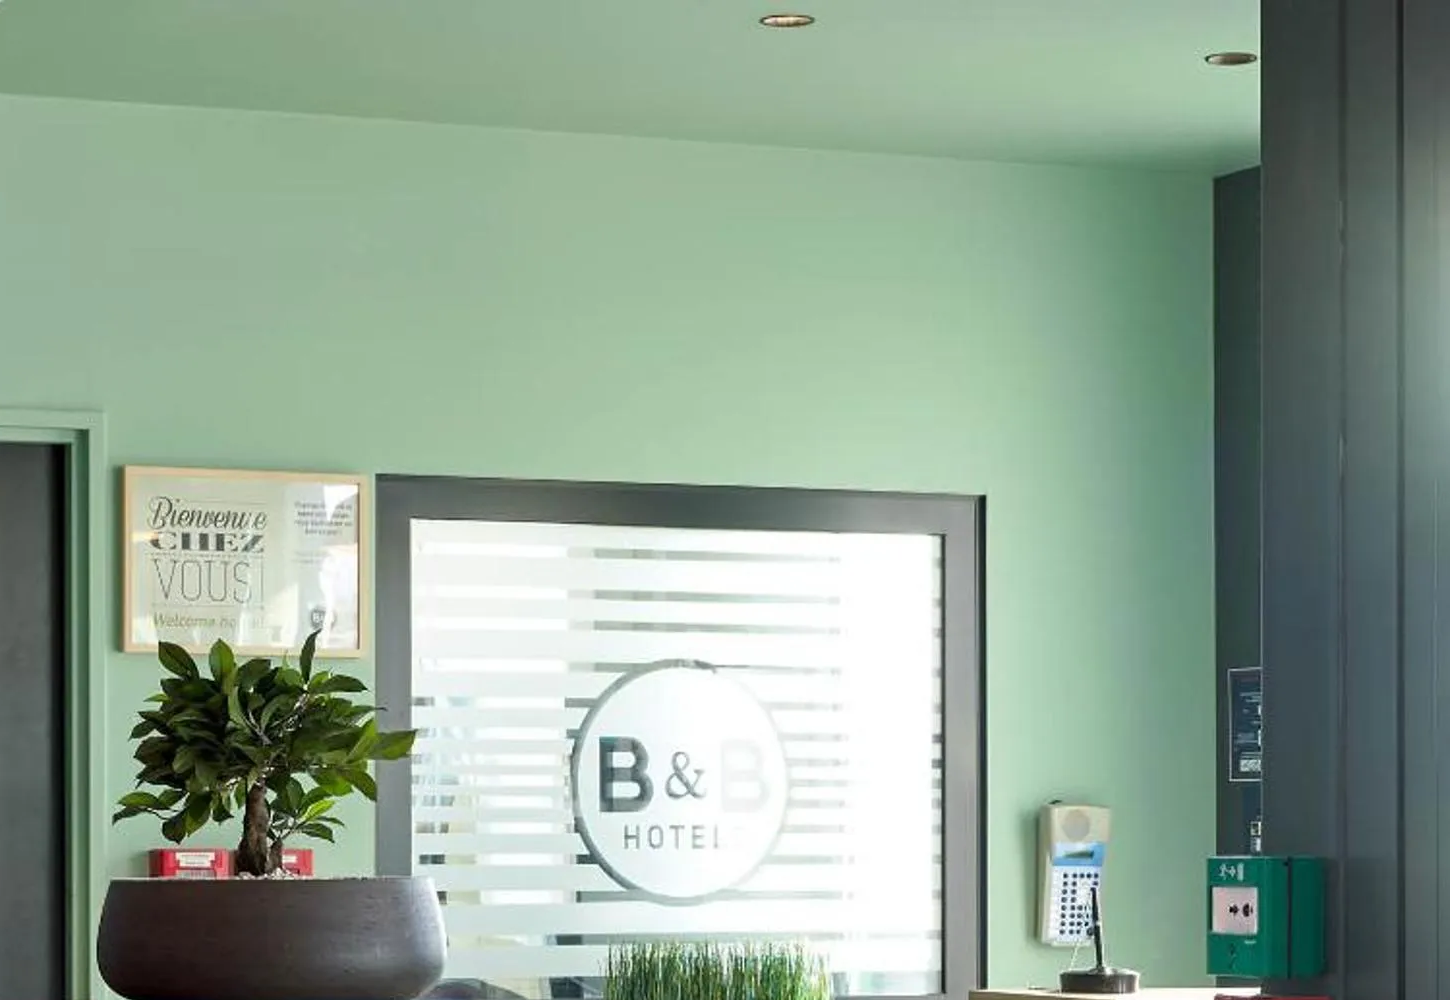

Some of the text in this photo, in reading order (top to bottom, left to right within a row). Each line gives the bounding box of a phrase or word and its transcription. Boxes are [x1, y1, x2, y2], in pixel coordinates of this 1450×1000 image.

[146, 495, 268, 530] Bienvenue
[149, 531, 265, 553] CHEZ
[623, 824, 745, 850] HOTEL
